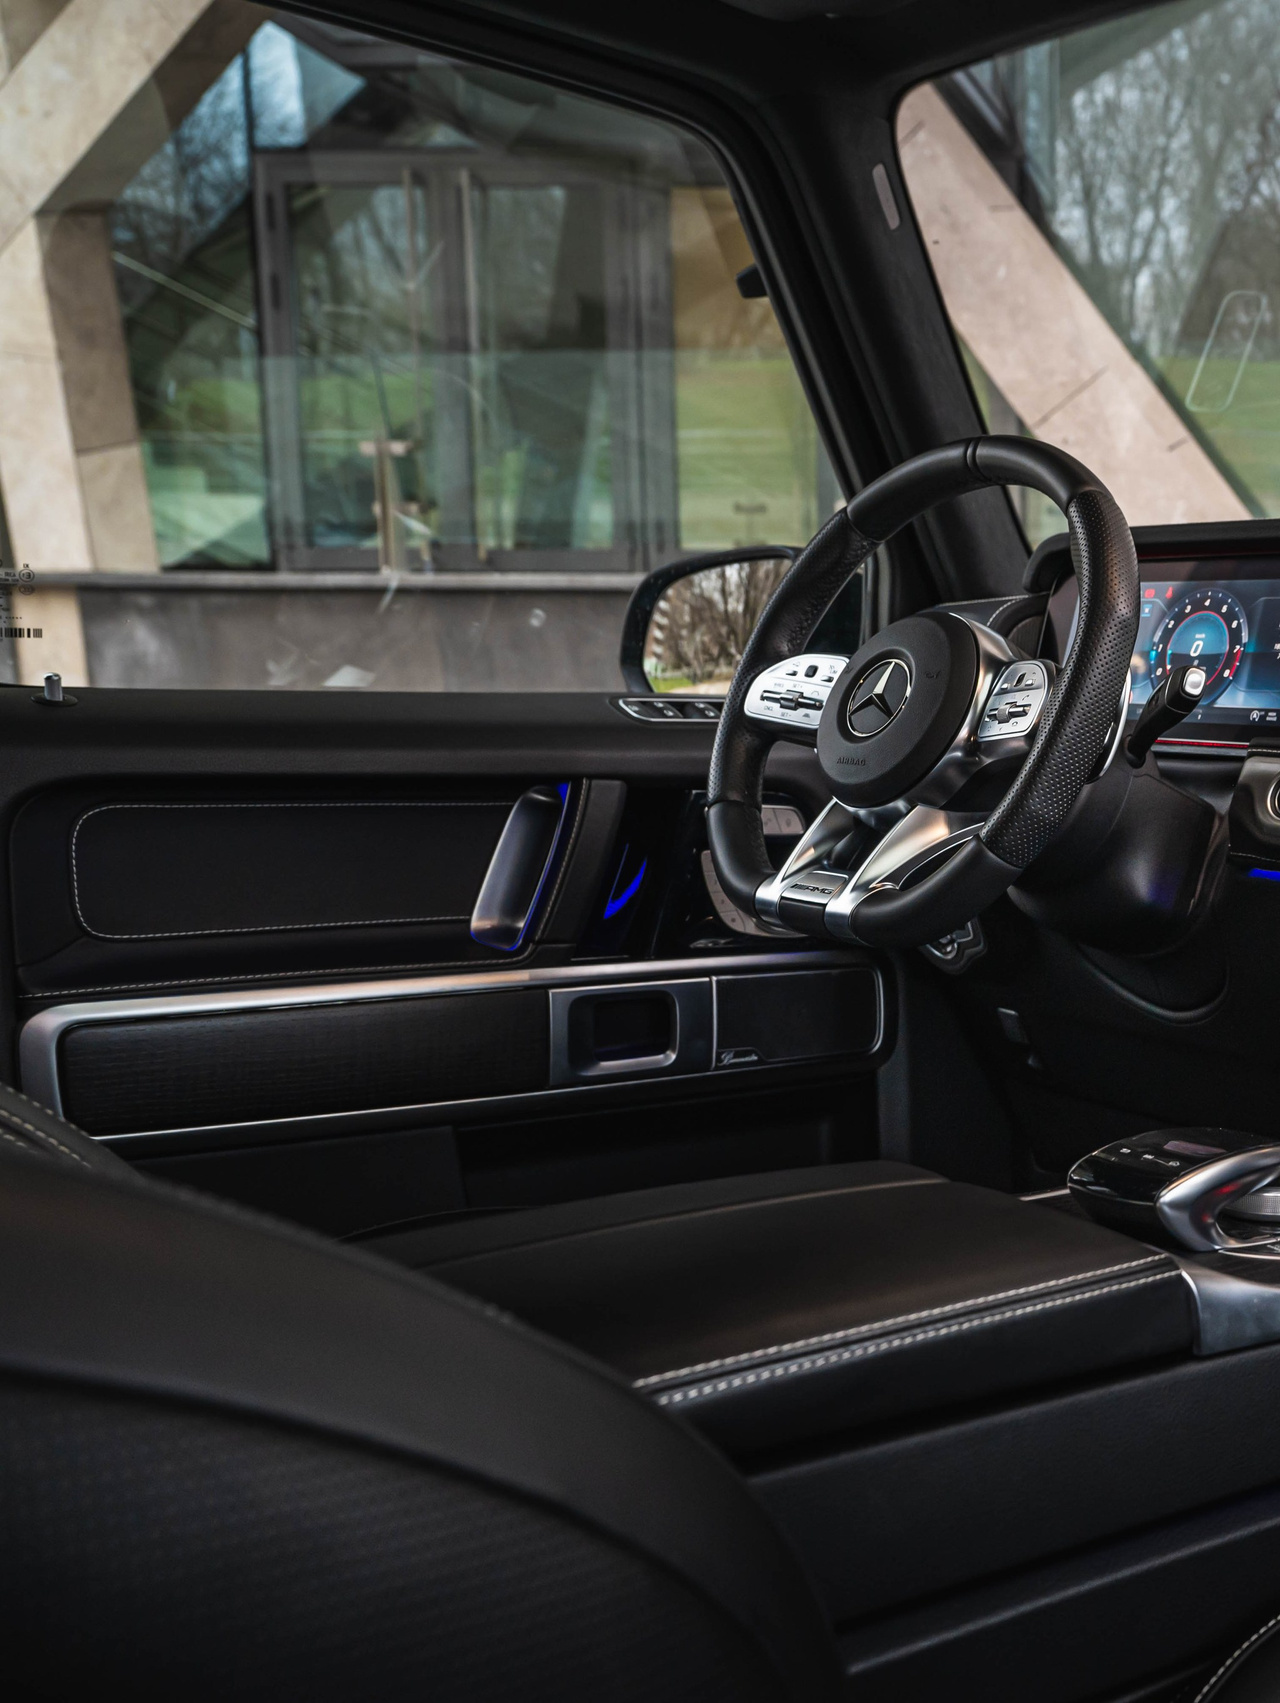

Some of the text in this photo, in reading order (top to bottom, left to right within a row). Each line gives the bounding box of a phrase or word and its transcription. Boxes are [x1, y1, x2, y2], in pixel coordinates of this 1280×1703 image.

[1185, 605, 1192, 613] 3
[1221, 605, 1228, 613] 5
[1168, 620, 1175, 628] 2
[1231, 620, 1238, 628] 6
[1158, 644, 1163, 652] 1
[1189, 640, 1204, 657] 0
[1233, 645, 1240, 653] 7
[1223, 669, 1230, 677] 8
[836, 757, 866, 766] AIRBAG
